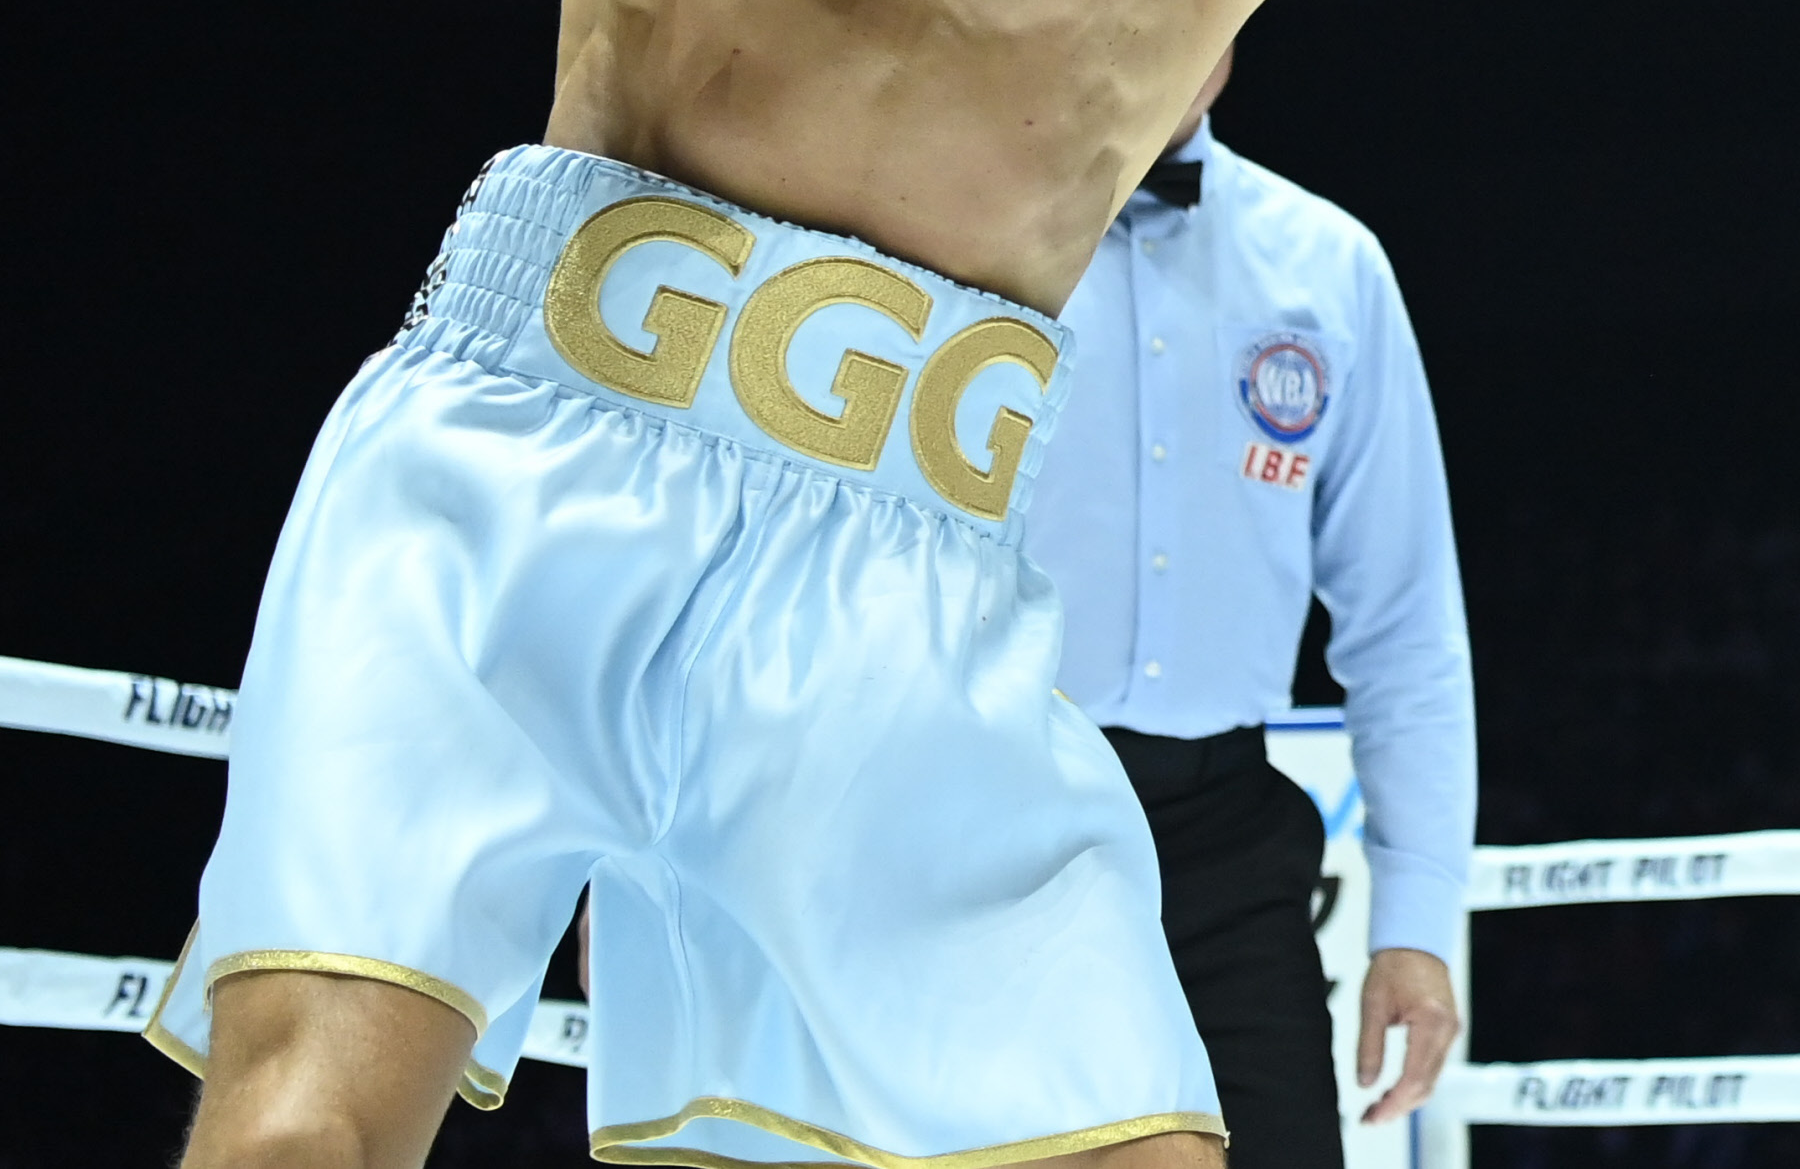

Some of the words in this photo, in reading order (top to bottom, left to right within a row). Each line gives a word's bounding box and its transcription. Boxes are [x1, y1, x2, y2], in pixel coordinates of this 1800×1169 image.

[543, 195, 1059, 520] GGG
[1244, 445, 1310, 487] IBF
[124, 673, 238, 734] FLIGH
